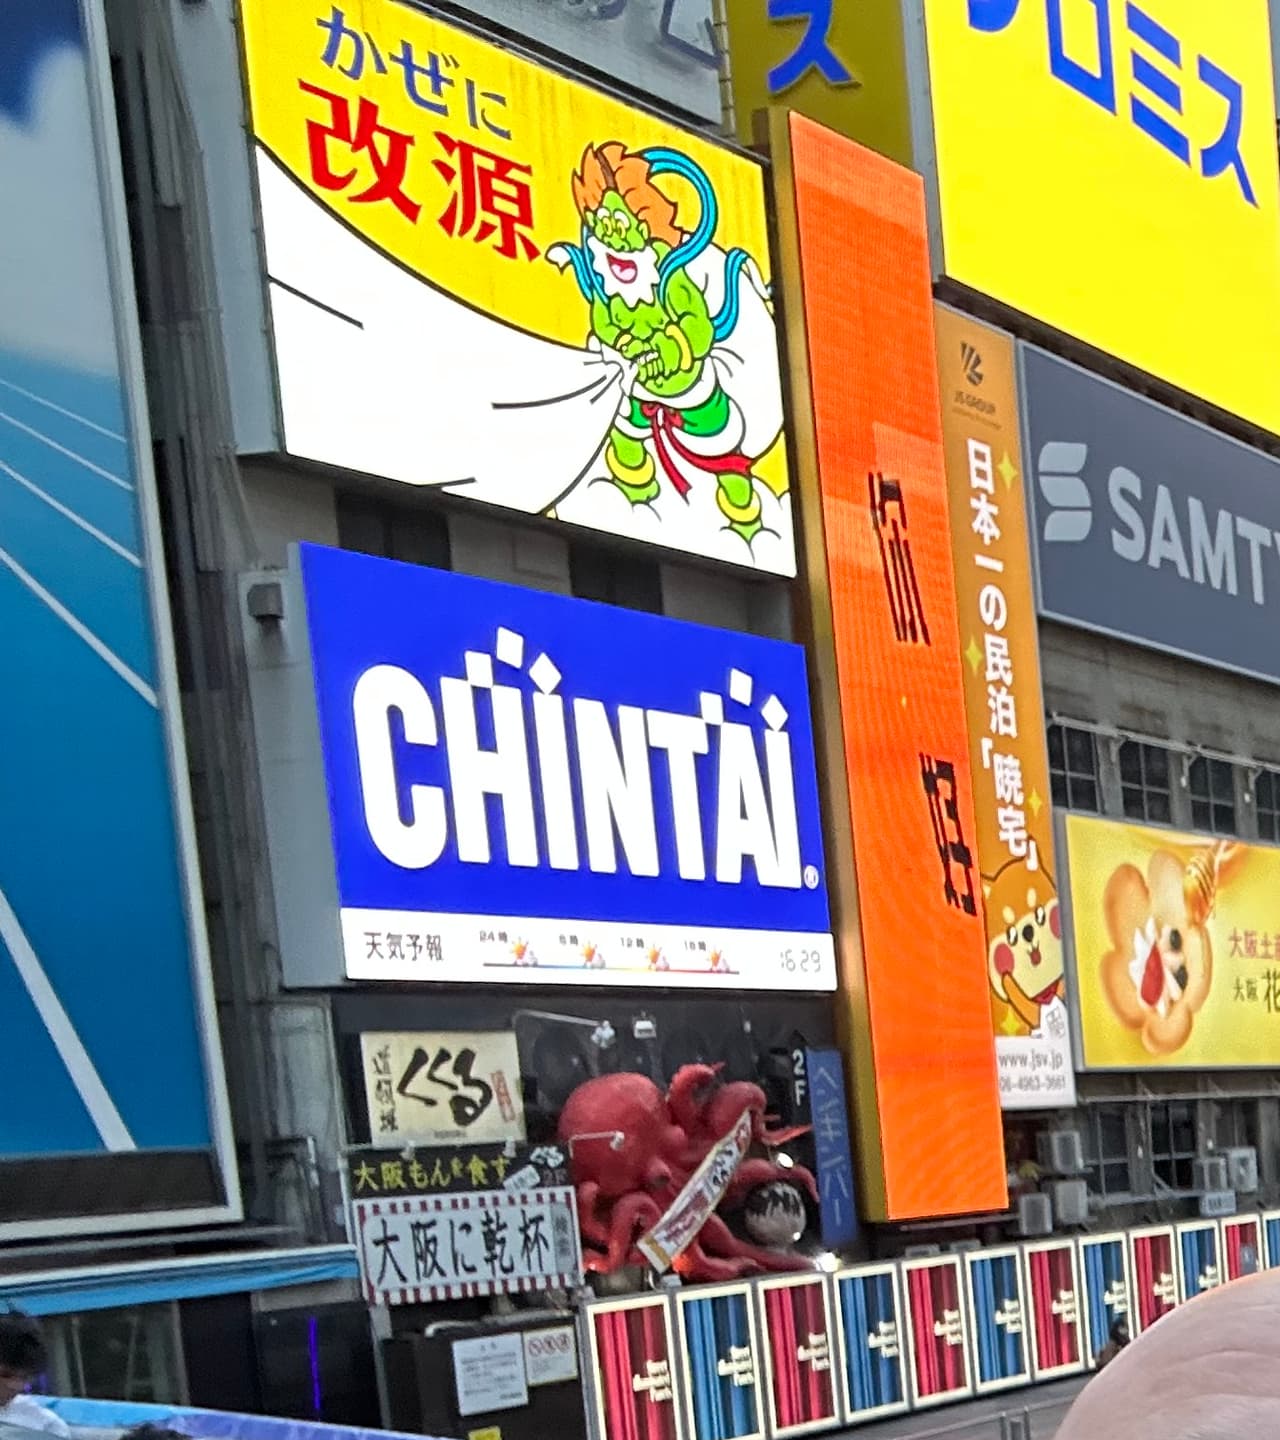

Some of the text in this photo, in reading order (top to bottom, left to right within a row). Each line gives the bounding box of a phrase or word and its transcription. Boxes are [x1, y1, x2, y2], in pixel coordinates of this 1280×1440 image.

[316, 5, 512, 141] かぜに
[967, 0, 1260, 209] ロミス
[299, 79, 542, 264] 改源
[351, 626, 802, 891] CHINTAI
[363, 931, 445, 963] 天気予報
[397, 1047, 493, 1127] くくる
[792, 1049, 807, 1106] 2F
[371, 1208, 550, 1286] 大阪に乾杯
